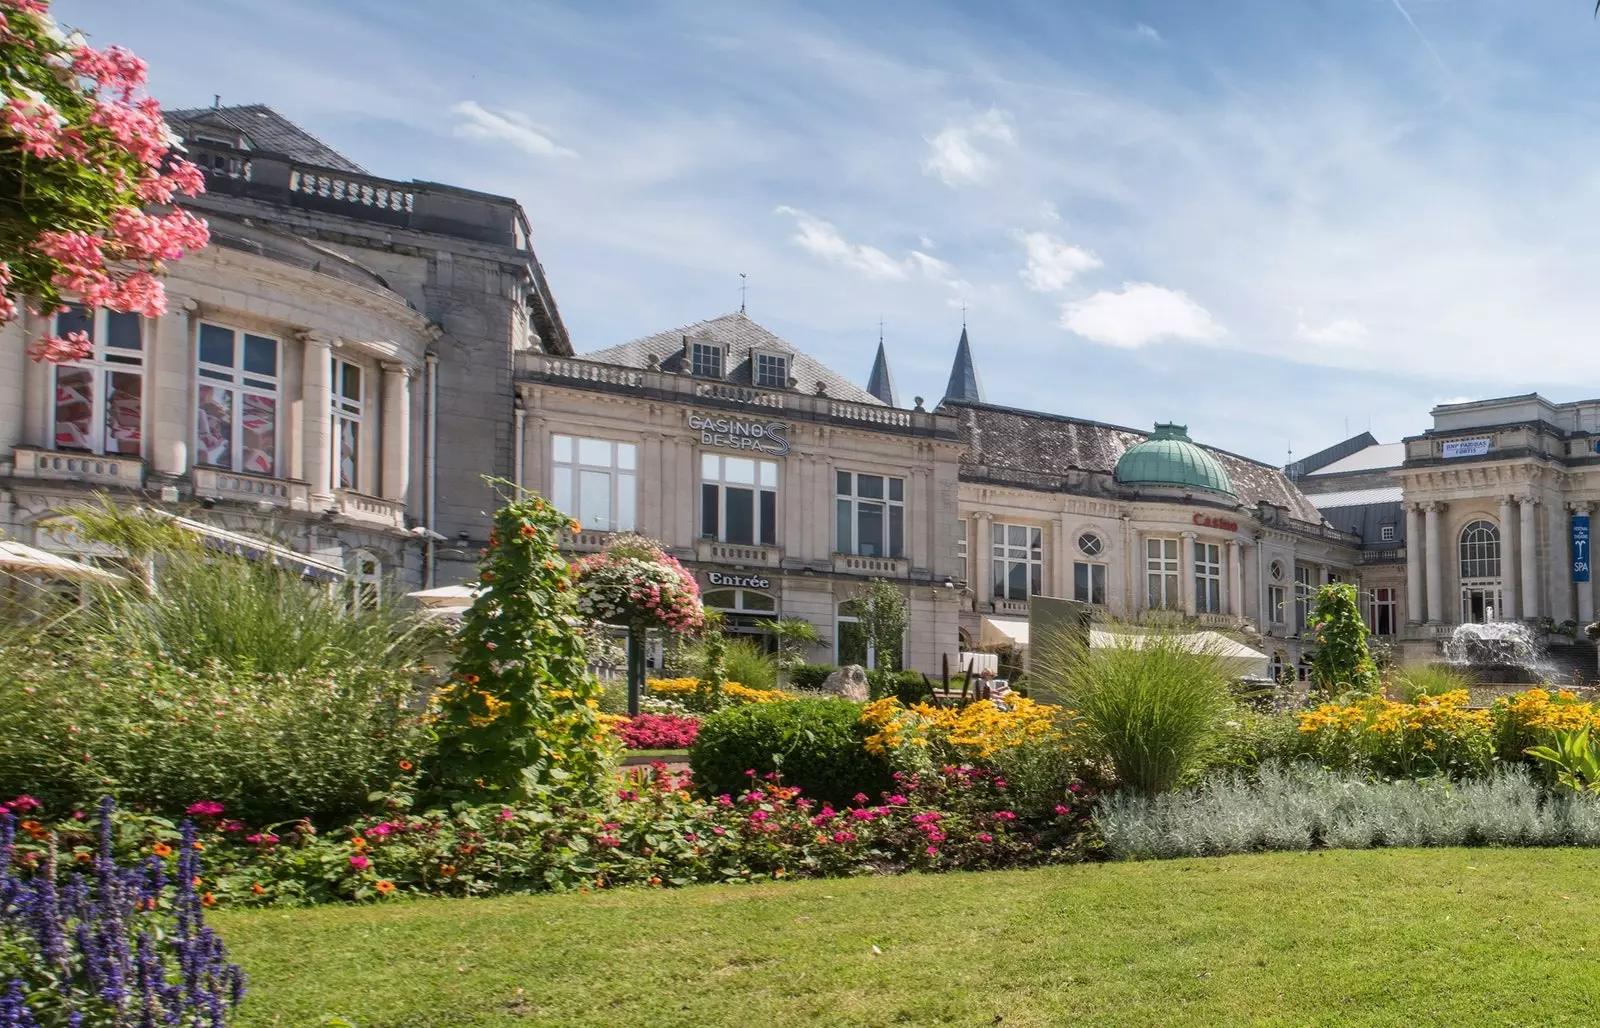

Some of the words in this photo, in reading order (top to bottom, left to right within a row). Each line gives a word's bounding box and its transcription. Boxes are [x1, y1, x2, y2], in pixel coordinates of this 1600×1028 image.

[688, 415, 763, 438] CASINO
[701, 431, 725, 447] DE
[729, 434, 763, 452] SPA
[1192, 512, 1238, 532] Casino
[1574, 562, 1588, 572] SPA
[708, 572, 769, 588] Entrée
